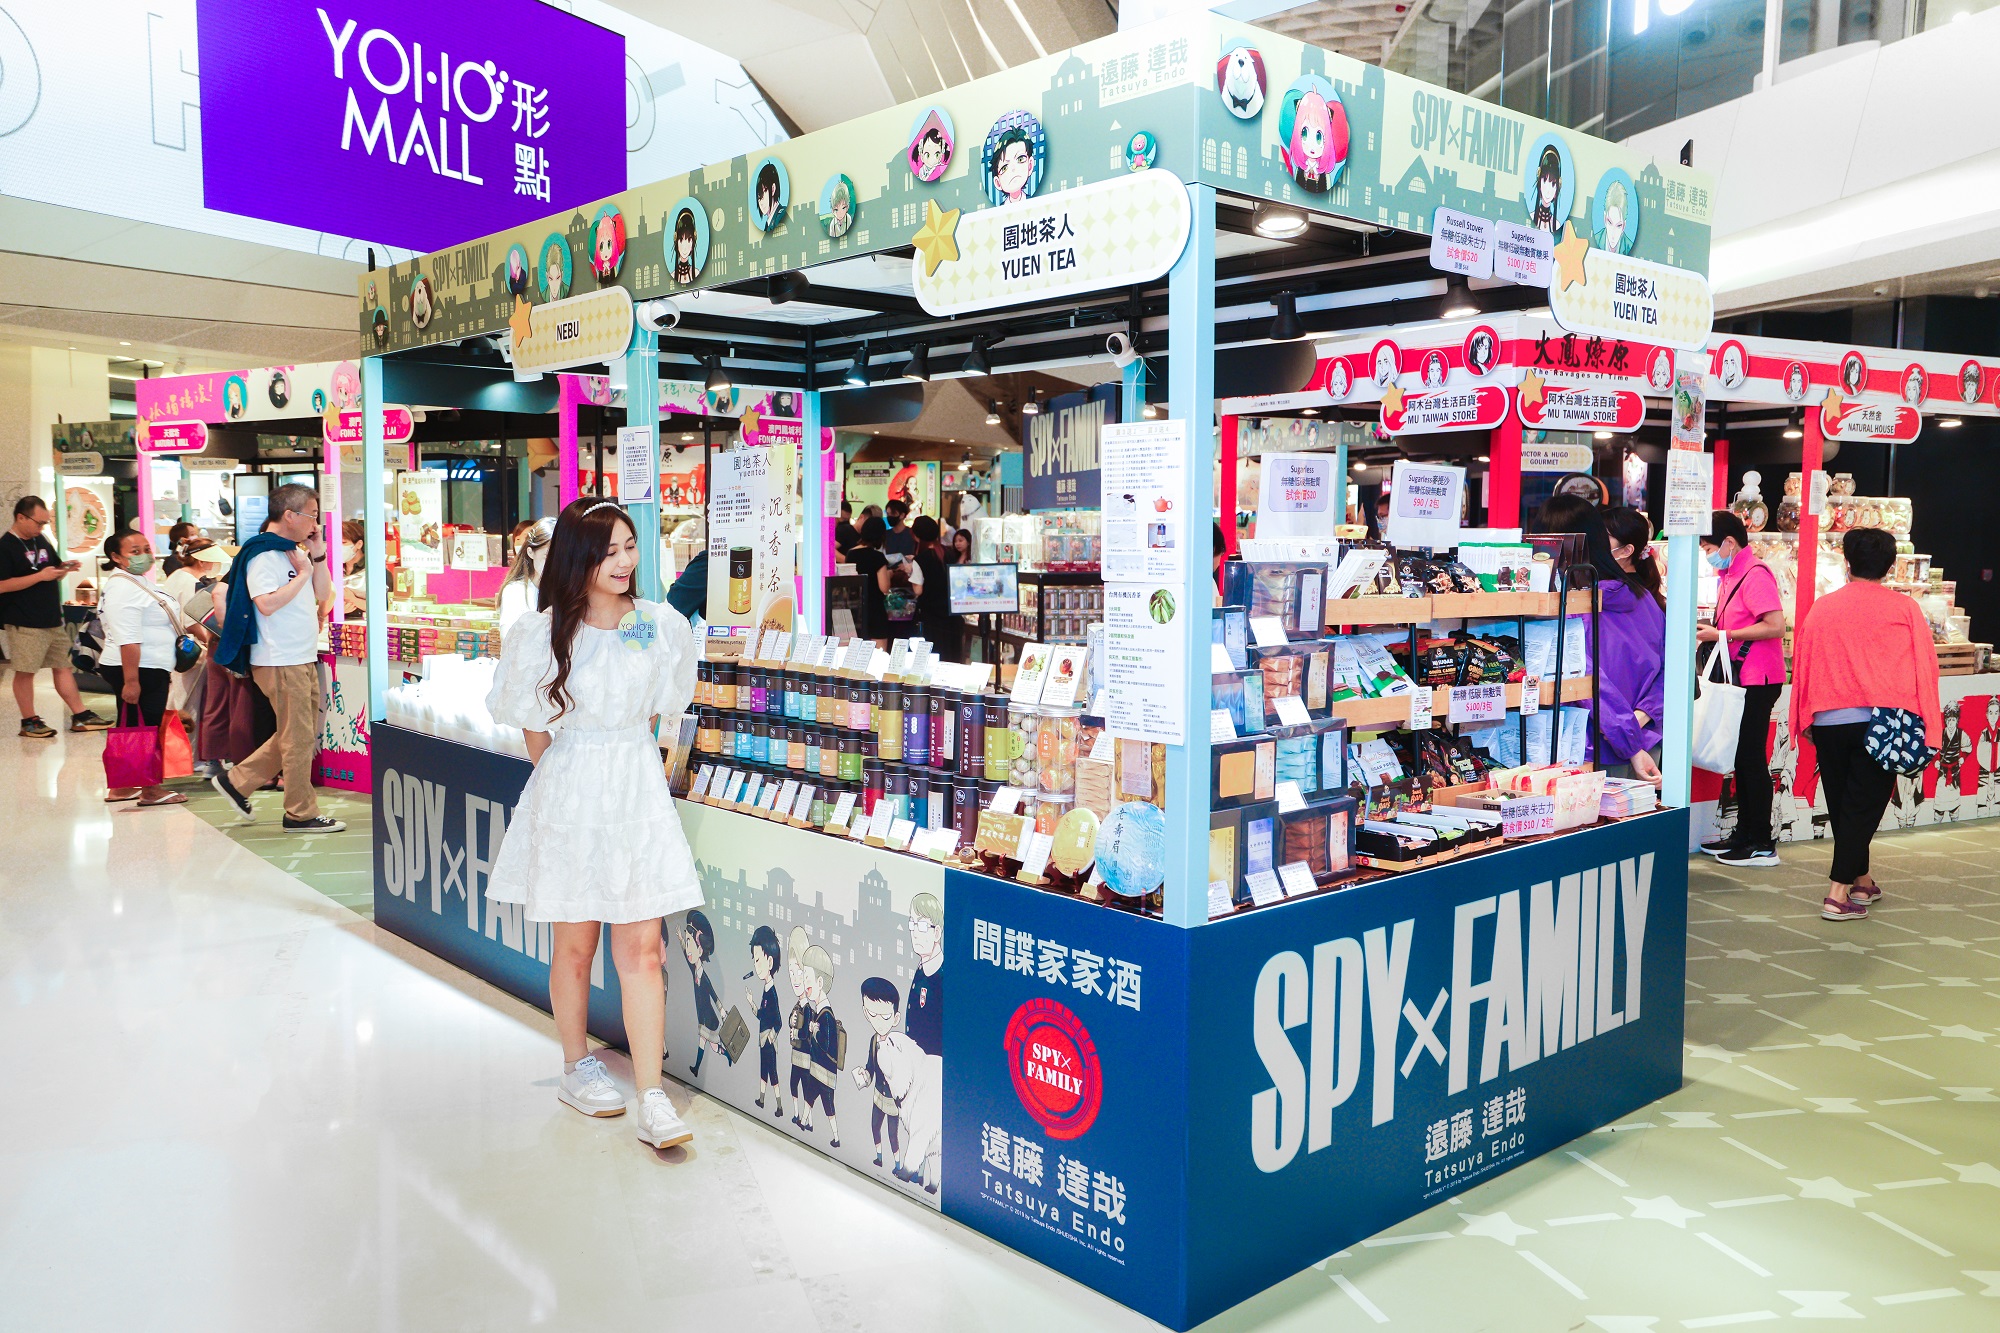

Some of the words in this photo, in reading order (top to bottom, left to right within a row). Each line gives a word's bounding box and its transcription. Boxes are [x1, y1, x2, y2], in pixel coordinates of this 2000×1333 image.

[316, 8, 509, 122] YOHO
[1101, 51, 1138, 88] 遠藤
[1147, 37, 1188, 73] 達哉
[1101, 78, 1148, 98] Tatsuya
[1155, 67, 1185, 83] Endo
[341, 87, 483, 185] MALL
[511, 80, 550, 202] 形點
[1666, 179, 1686, 202] 遠藤
[1689, 186, 1708, 208] 達哉
[1003, 212, 1074, 252] 園地茶人
[1447, 215, 1466, 229] Russell
[1467, 221, 1484, 234] Stover
[1511, 230, 1535, 244] Sugarless
[1002, 254, 1041, 280] YUEN
[1048, 248, 1076, 272] TEA
[1507, 256, 1520, 268] $100
[1526, 261, 1537, 274] 3包
[1615, 273, 1658, 301] 園地茶人
[1613, 301, 1637, 322] YUEN
[1641, 309, 1658, 325] TEA
[556, 321, 579, 341] NEBU
[1534, 329, 1629, 371] 火鳳燎原
[1533, 367, 1550, 376] The
[1553, 370, 1587, 381] Ravages
[1590, 372, 1604, 381] of
[1608, 373, 1629, 381] Time
[1408, 394, 1476, 411] 阿木台灣生活百貨
[1548, 393, 1617, 409] 阿木台灣生活百貨
[1407, 413, 1420, 424] MU
[1422, 411, 1449, 423] TAIWAN
[1452, 409, 1477, 421] STORE
[1547, 409, 1560, 420] MU
[1563, 409, 1590, 421] TAIWAN
[1593, 411, 1617, 422] STORE
[1861, 410, 1882, 422] 天然舍
[340, 429, 356, 438] FONG
[387, 427, 396, 435] LAI
[1848, 423, 1873, 433] NATURAL
[1874, 424, 1894, 434] HOUSE
[734, 453, 771, 470] 園地茶人
[1290, 465, 1314, 475] Sugarless
[739, 469, 765, 480] yuentea
[1413, 498, 1424, 507] $90
[1430, 498, 1439, 508] 2包
[621, 623, 647, 631] YOHO
[1466, 701, 1492, 712] $100/3包
[1502, 804, 1530, 819] 無糖低碳
[1531, 801, 1553, 815] 朱古力
[1524, 819, 1535, 830] $10
[973, 918, 1142, 1011] 間諜家家酒
[1027, 1061, 1083, 1096] FAMILY
[1425, 1108, 1473, 1164] 遠藤
[1482, 1087, 1526, 1141] 達哉
[1425, 1151, 1483, 1188] Tatsuya
[1491, 1132, 1525, 1159] Endo
[981, 1121, 1044, 1188] 遠藤
[1056, 1154, 1127, 1226] 達哉
[981, 1169, 1060, 1222] Tatsuya
[1073, 1214, 1125, 1252] Endo
